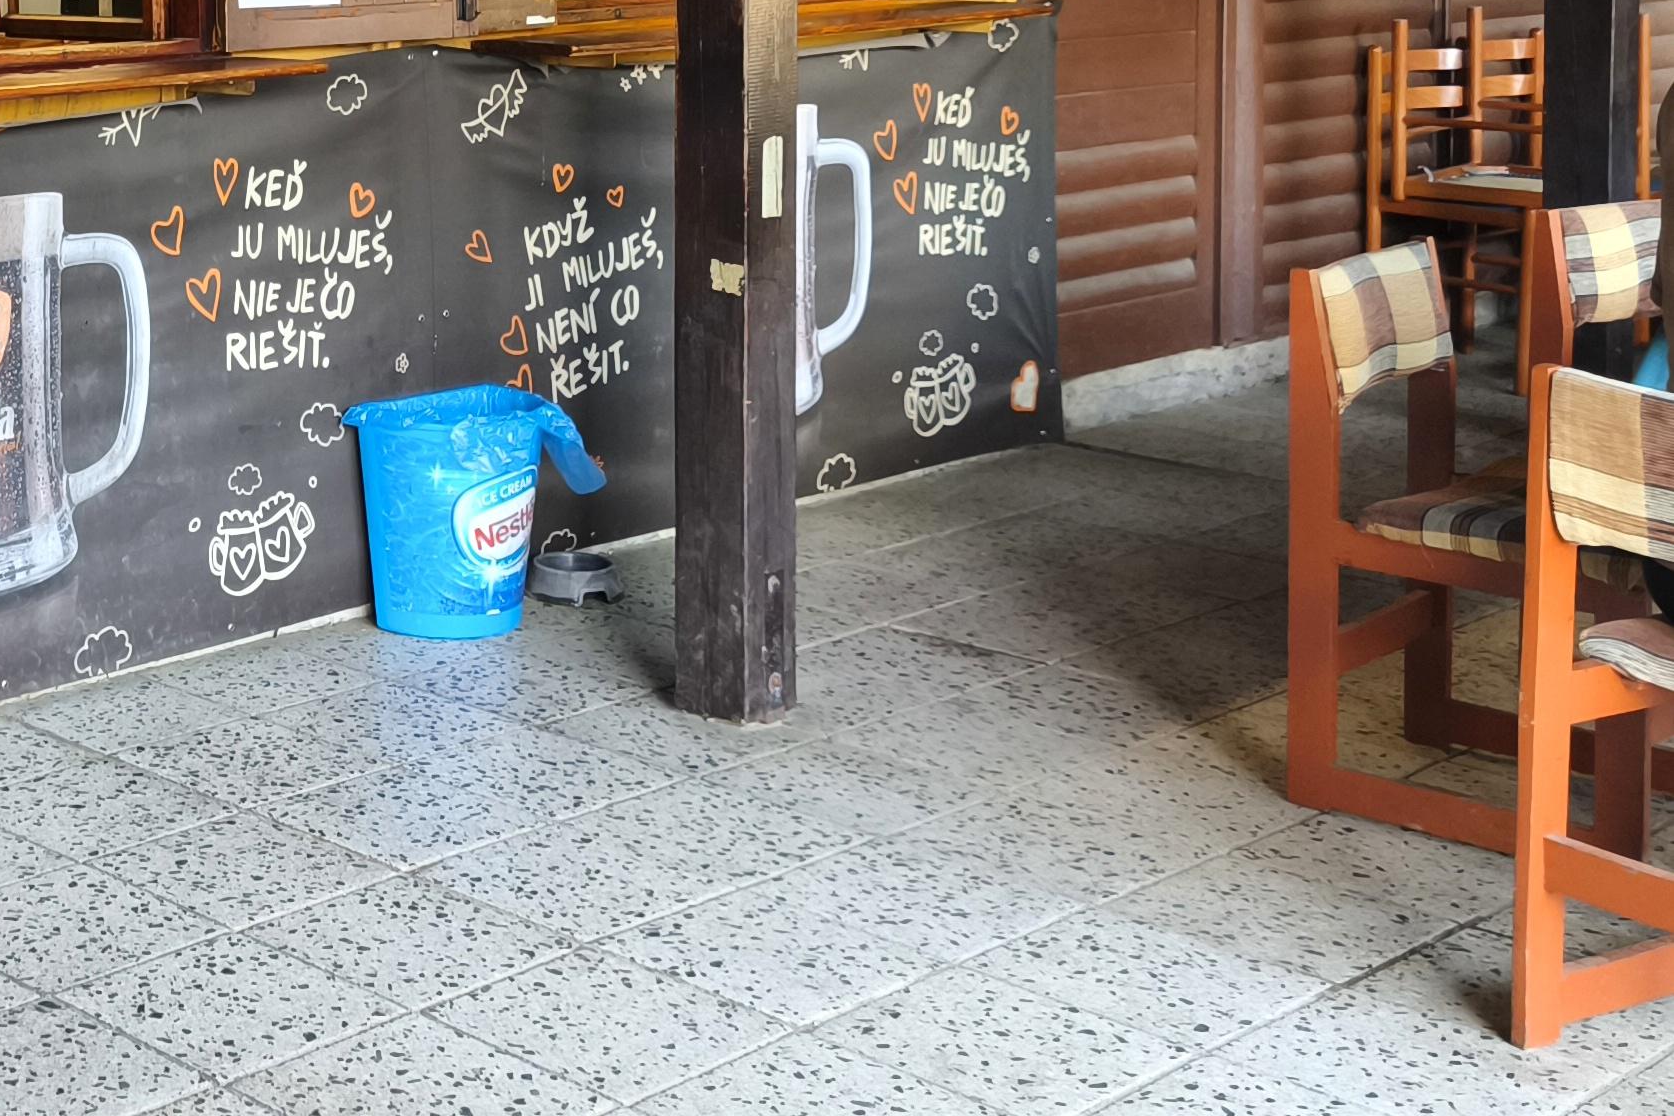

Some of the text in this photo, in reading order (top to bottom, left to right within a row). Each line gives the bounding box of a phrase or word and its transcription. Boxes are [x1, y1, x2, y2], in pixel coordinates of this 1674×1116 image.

[933, 86, 976, 128] KEĎ
[921, 128, 1032, 183] JU MILUJEŠ,
[244, 159, 308, 212] KEĎ
[924, 174, 1007, 218] NIE JE ČO
[230, 209, 394, 275] JU MILUJEŠ,
[523, 196, 595, 267] KDYŽ
[918, 215, 988, 257] RIEŠIŤ.
[524, 207, 665, 314] JI MILUJEŠ,
[233, 266, 356, 321] NIE JE ČO
[535, 284, 641, 356] NENÍ CO
[226, 318, 331, 373] RIEŠIŤ.
[549, 338, 631, 405] ŘEŠIT.
[499, 475, 533, 499] CREAM
